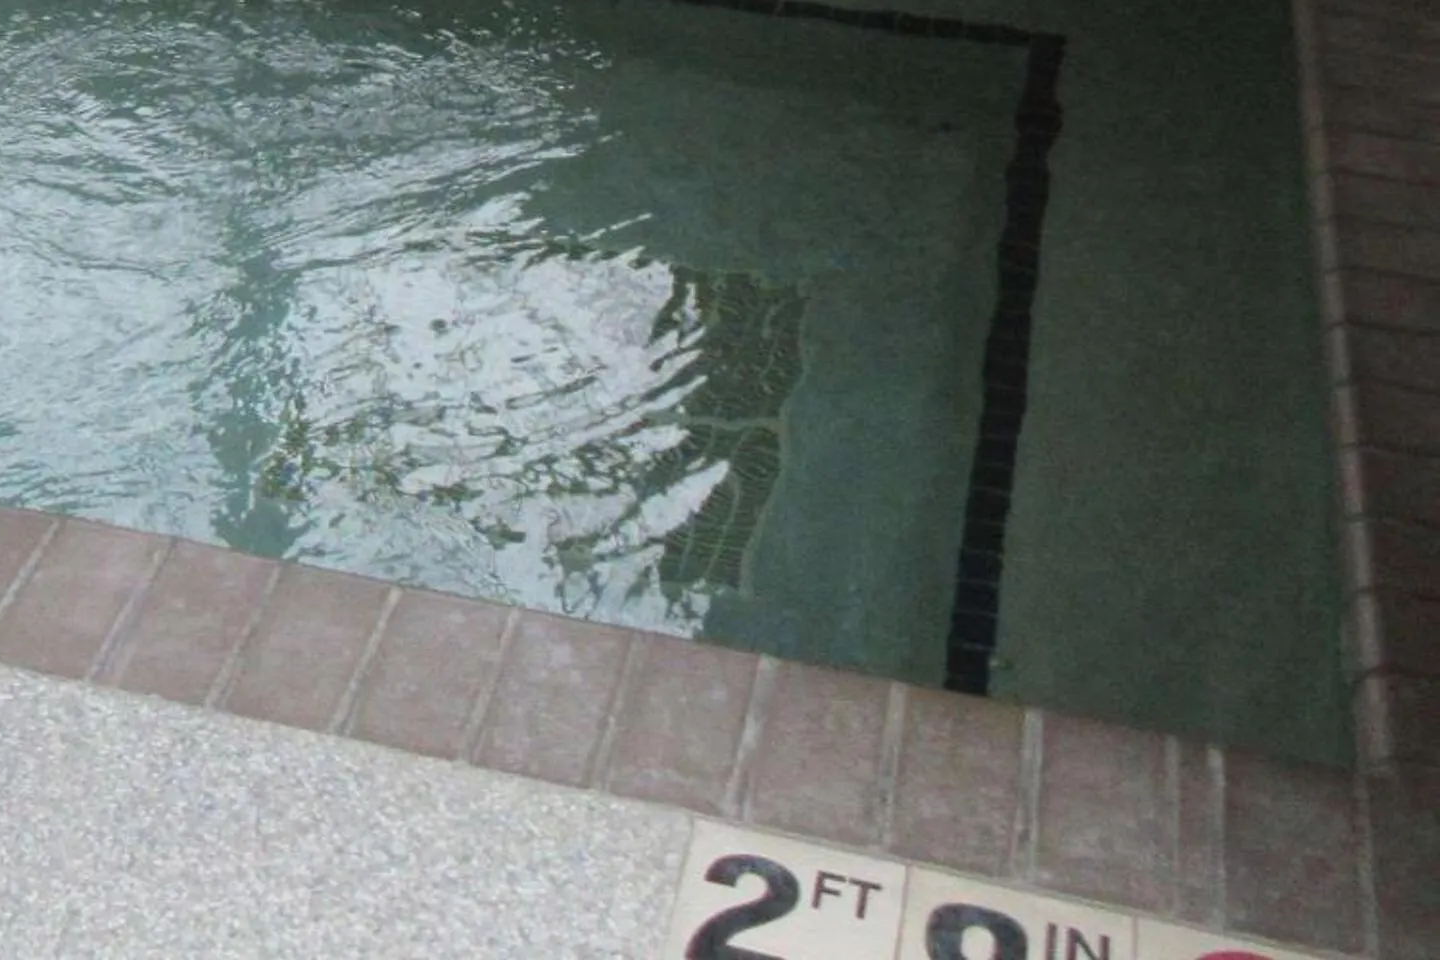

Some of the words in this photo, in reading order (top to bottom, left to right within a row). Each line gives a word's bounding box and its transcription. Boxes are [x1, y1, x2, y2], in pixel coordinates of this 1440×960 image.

[685, 854, 800, 960] 2
[812, 870, 883, 920] FT
[1045, 922, 1110, 960] IN
